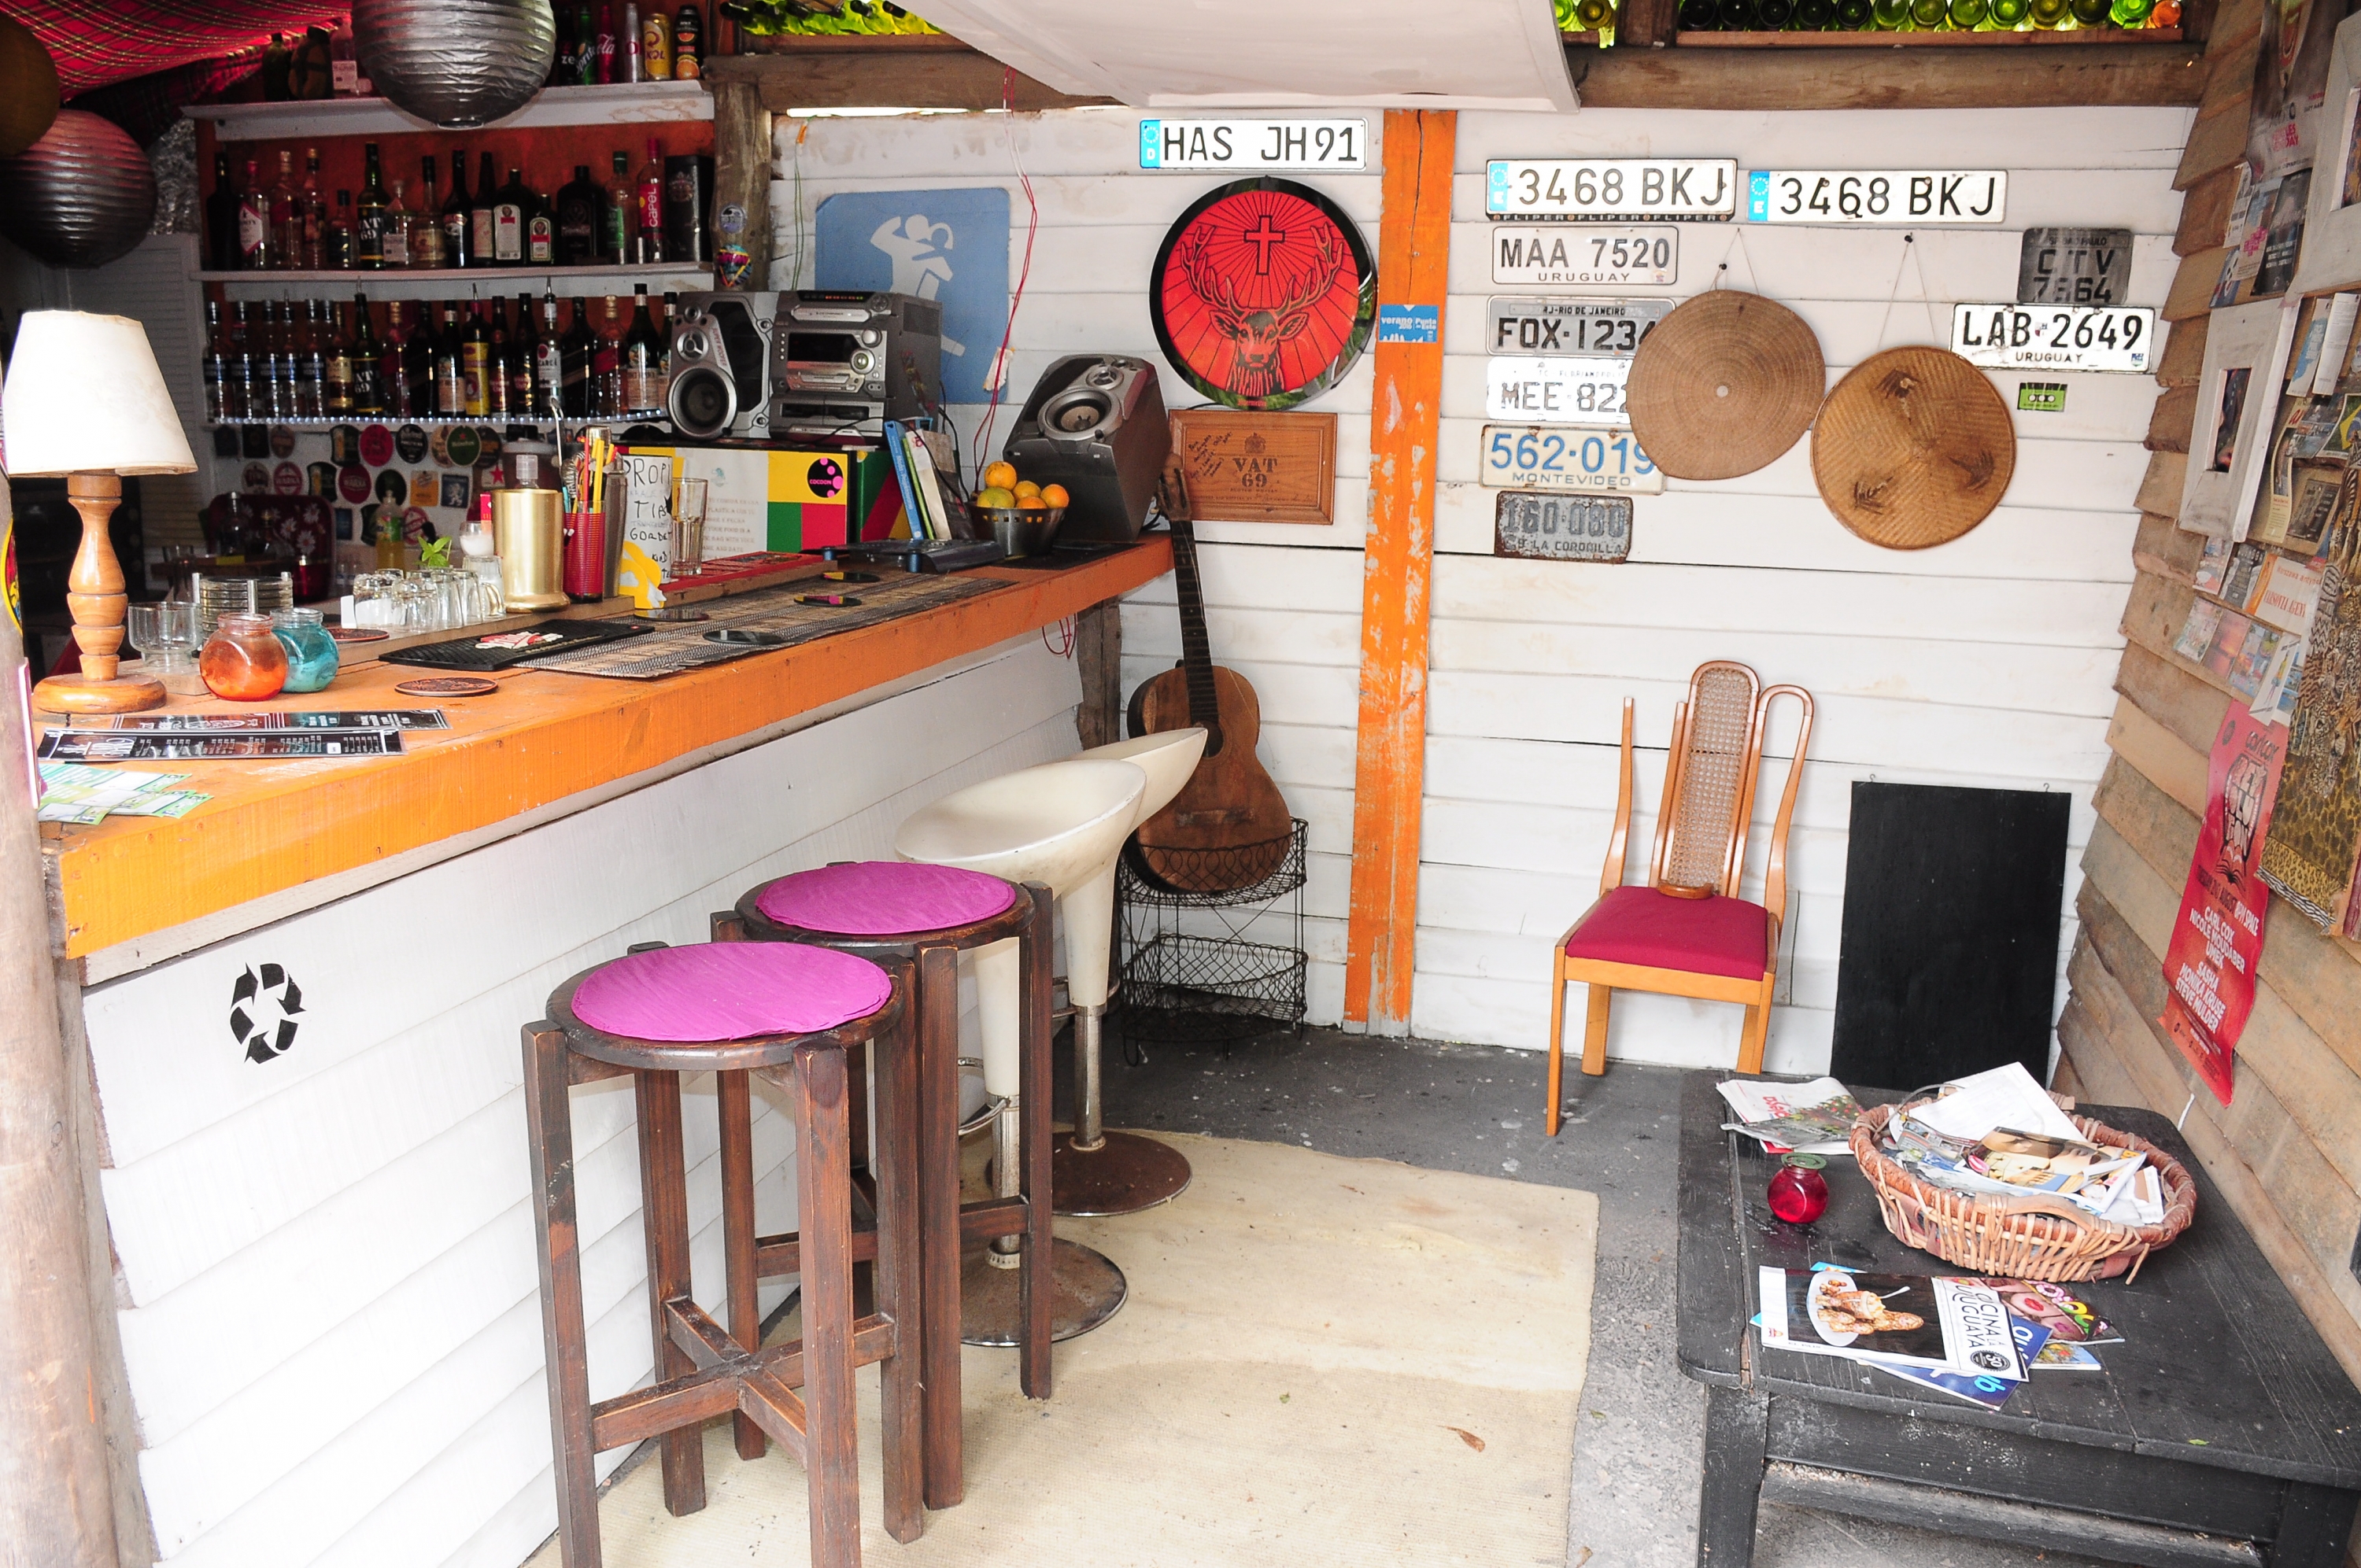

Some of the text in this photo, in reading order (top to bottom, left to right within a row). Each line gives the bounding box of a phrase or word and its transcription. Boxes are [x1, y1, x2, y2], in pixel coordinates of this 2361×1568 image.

[1164, 127, 1232, 160] HAS
[1519, 168, 1724, 206] 3468 BKJ
[1780, 177, 1996, 218] 3468 BKJ
[1753, 201, 1764, 214] E
[1501, 238, 1670, 268] MAA 7520
[1538, 273, 1631, 282] URUGUAY
[1576, 307, 1587, 315] DE
[1589, 307, 1626, 316] JANEIRO
[1963, 311, 2143, 350] LAB 2649
[2016, 352, 2082, 363] URUGUAY
[1232, 458, 1277, 473] VAT
[1512, 473, 1631, 486] MONTEVIDEO
[1241, 473, 1267, 488] 69
[2204, 906, 2235, 946] CARL COX
[2243, 909, 2259, 937] SPACE
[2189, 908, 2211, 939] NICOLE
[2211, 928, 2245, 974] MOUDABER
[2206, 940, 2225, 969] UMEK
[2197, 961, 2219, 991] SASHA
[2179, 962, 2205, 998] MONIKA
[2204, 987, 2226, 1020] KRUSE
[2175, 978, 2194, 1007] STEVE
[2193, 995, 2220, 1035] MULDER
[1985, 1353, 2002, 1368] 50
